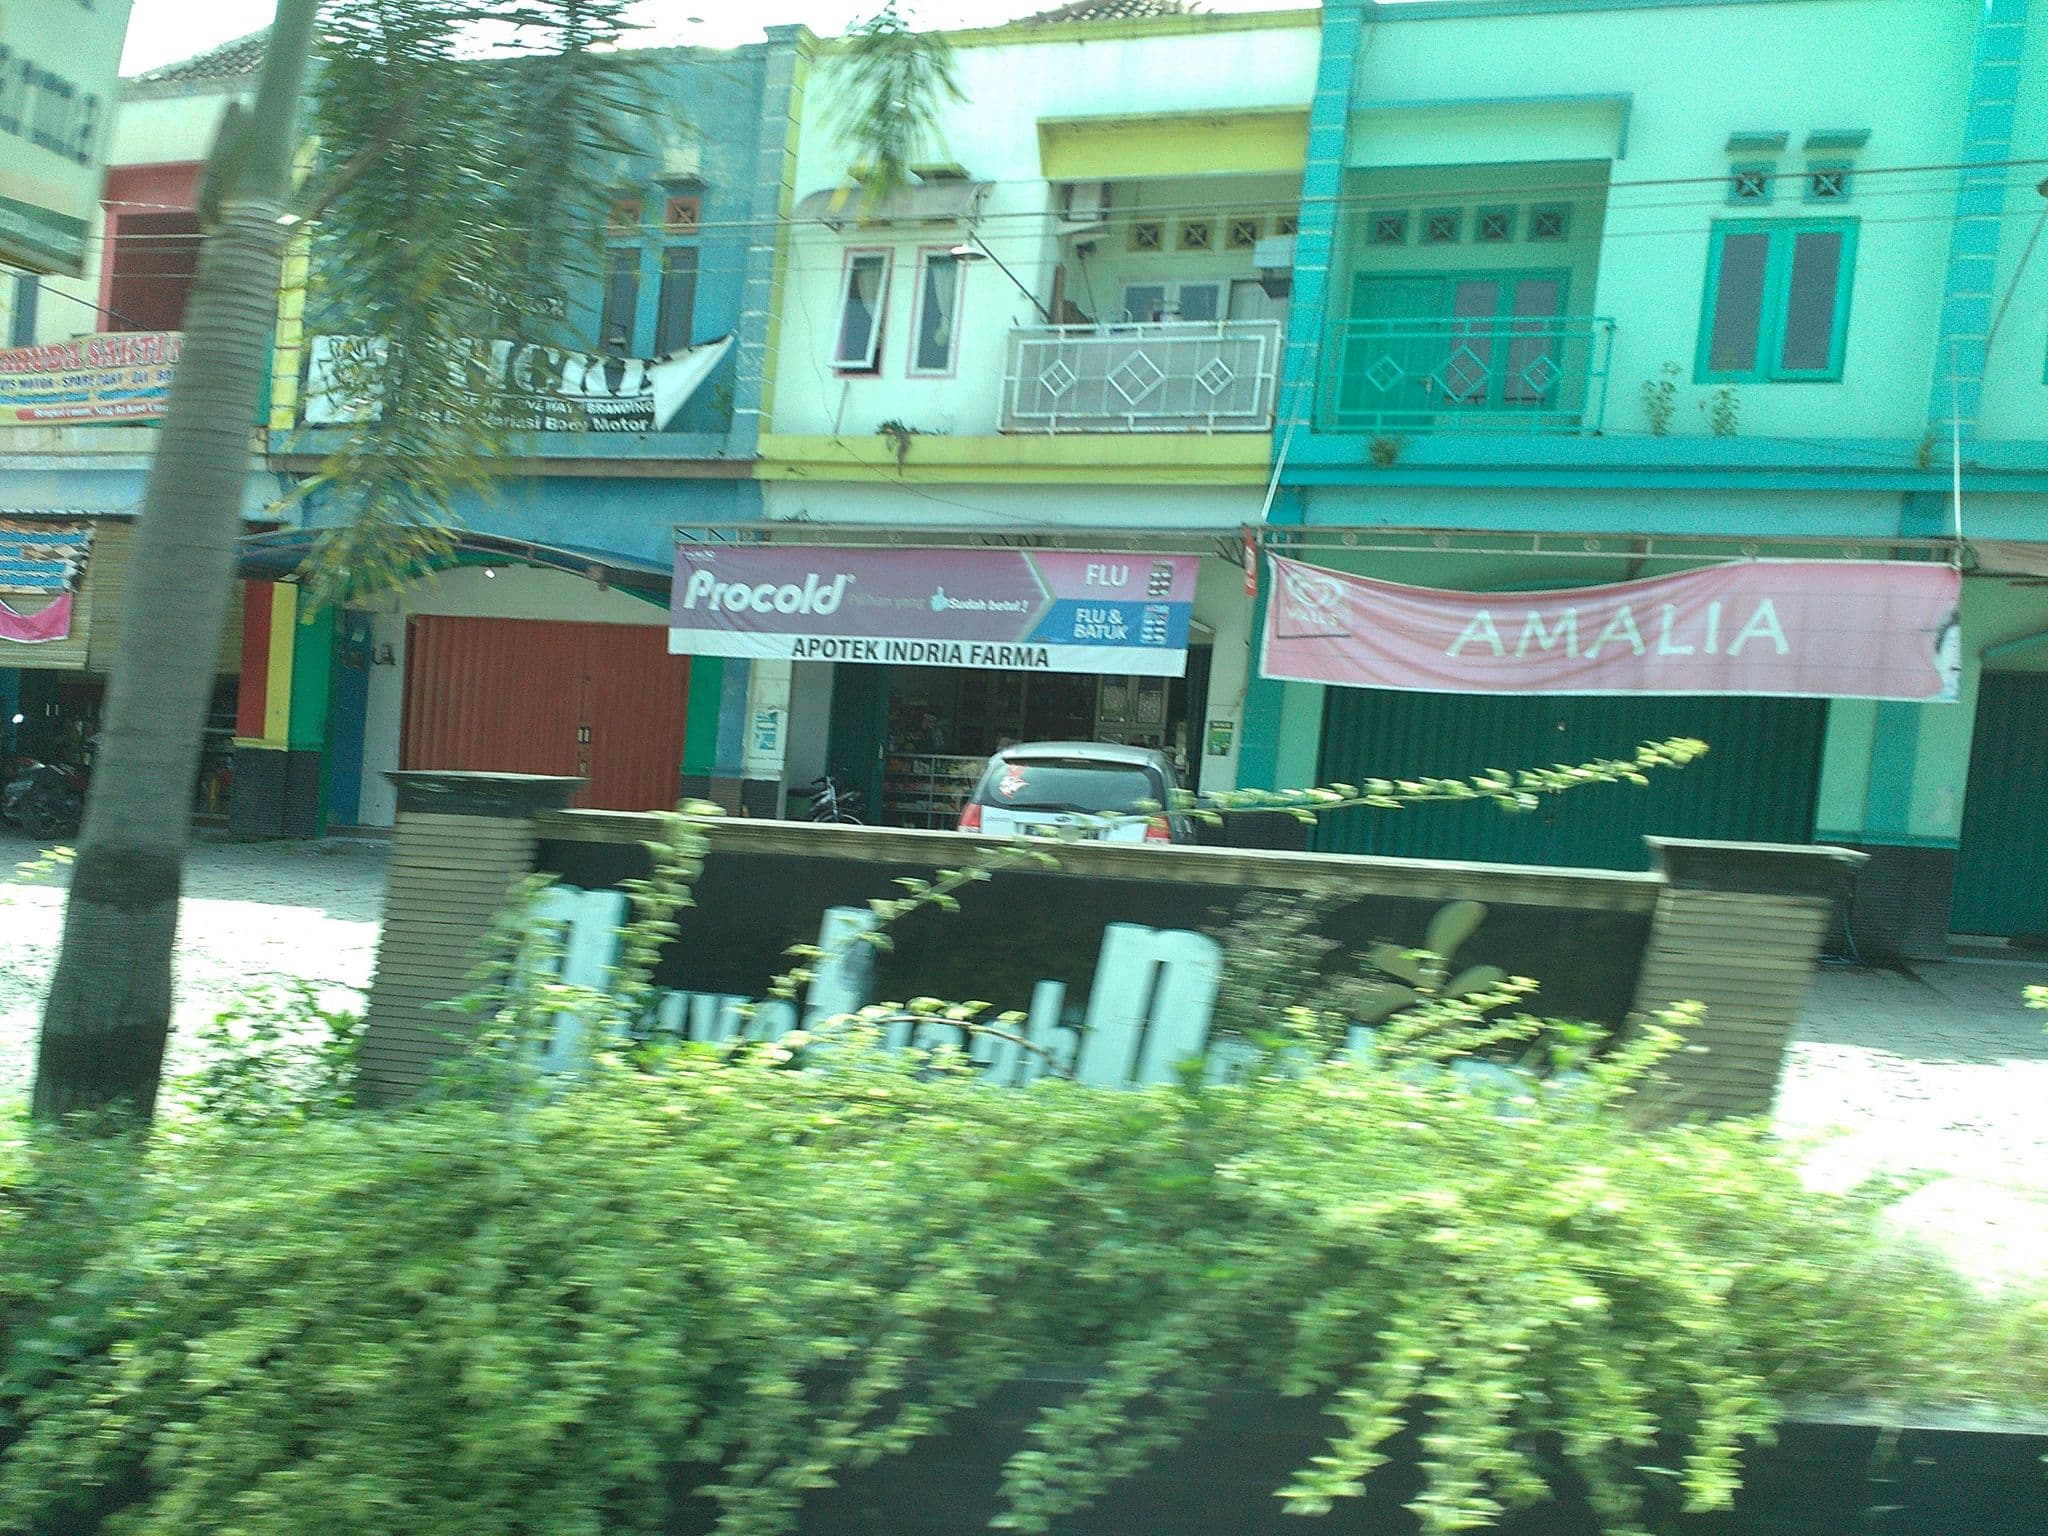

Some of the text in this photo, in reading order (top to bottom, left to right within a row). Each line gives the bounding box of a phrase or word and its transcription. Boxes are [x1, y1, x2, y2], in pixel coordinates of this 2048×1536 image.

[592, 417, 650, 432] Motor
[1086, 564, 1129, 588] FLU
[683, 569, 847, 616] Procold
[1075, 608, 1123, 625] FLU &
[1073, 624, 1129, 641] BATUK
[1445, 599, 1791, 660] AMALIA
[791, 638, 1050, 668] APOTEK INDRIA FARMA
